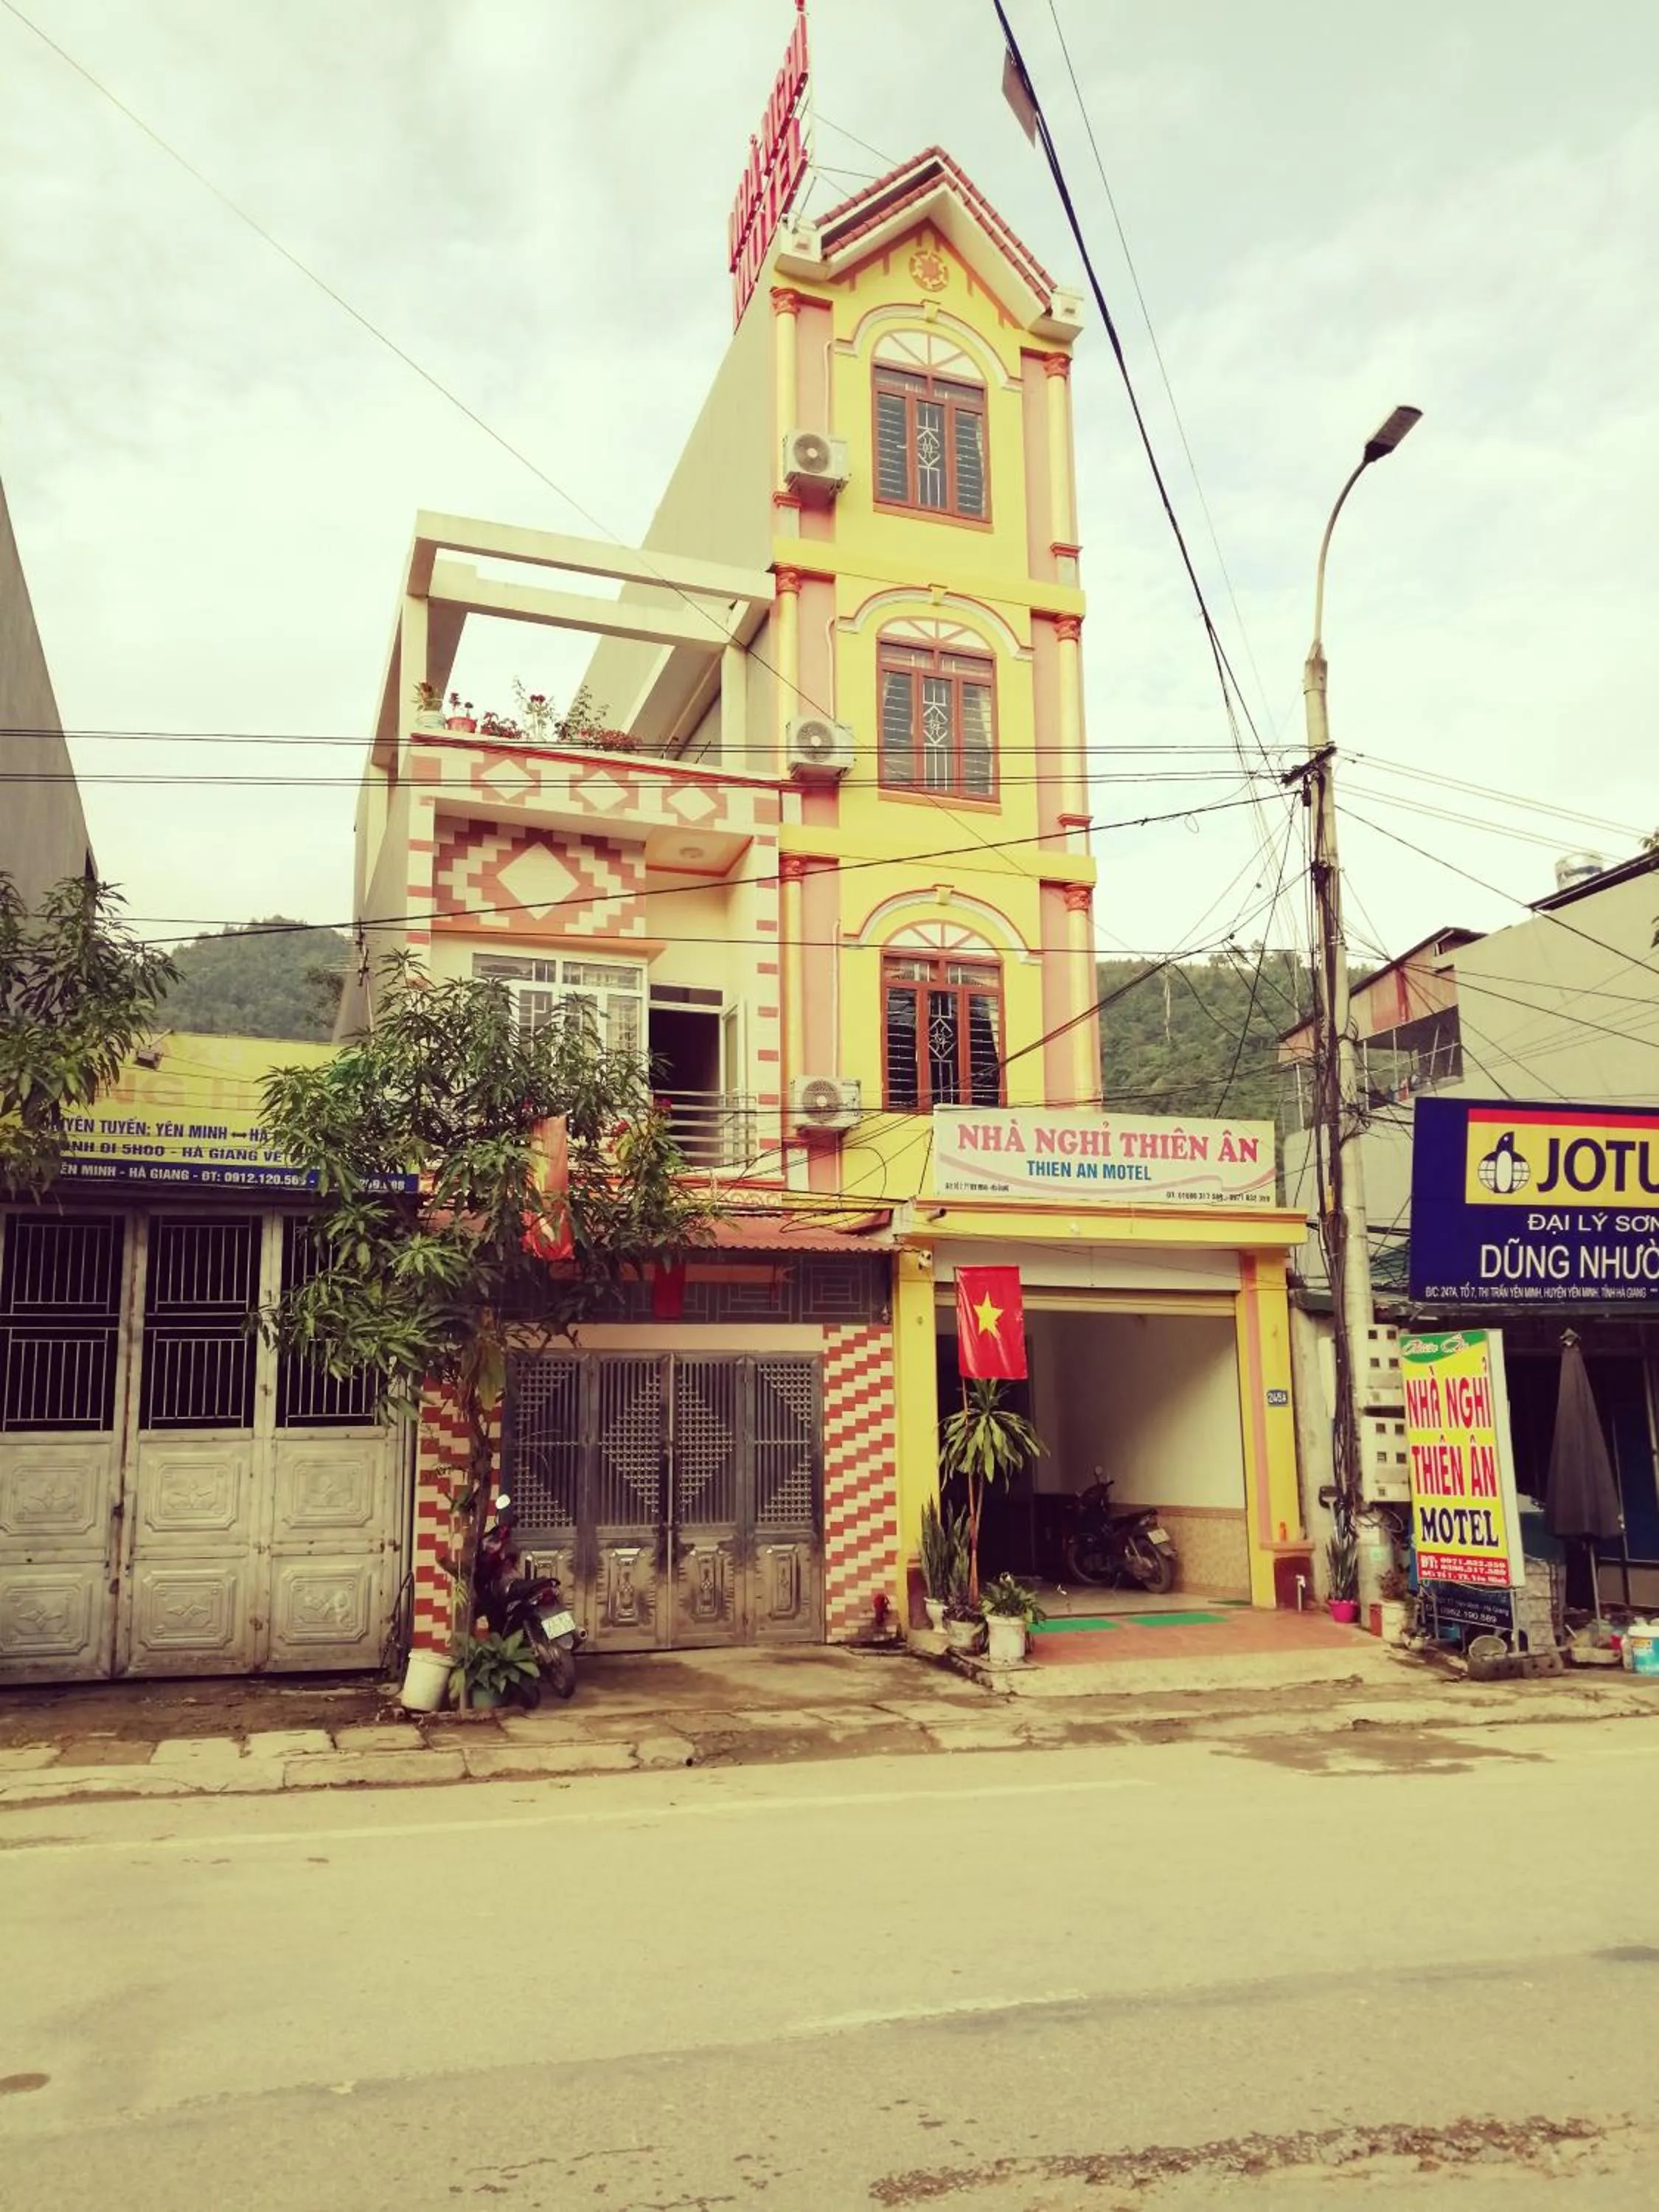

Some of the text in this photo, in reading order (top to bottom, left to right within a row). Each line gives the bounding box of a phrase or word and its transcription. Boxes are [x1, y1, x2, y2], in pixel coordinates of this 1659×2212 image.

[100, 1116, 150, 1136] TUYẾN:
[156, 1120, 184, 1138] YÊN
[189, 1124, 228, 1140] MINH
[958, 1119, 1259, 1163] NHÀ NGHỈ THIÊN ÂN
[122, 1144, 164, 1157] 5H00
[182, 1145, 204, 1158] HÀ
[209, 1149, 257, 1161] GIANG
[60, 1161, 77, 1175] ÊN
[81, 1165, 116, 1177] MINH
[129, 1166, 146, 1178] HÀ
[150, 1168, 189, 1180] GIANG
[1026, 1160, 1152, 1181] THIEN AN MOTEL
[1527, 1214, 1570, 1235] ĐẠI
[1578, 1211, 1608, 1232] LÝ
[1481, 1238, 1570, 1279] DŨNG
[1406, 1356, 1491, 1429] NHÀ NGHỈ
[1411, 1434, 1498, 1498] THIÊN ÂN
[1419, 1506, 1499, 1548] MOTEL
